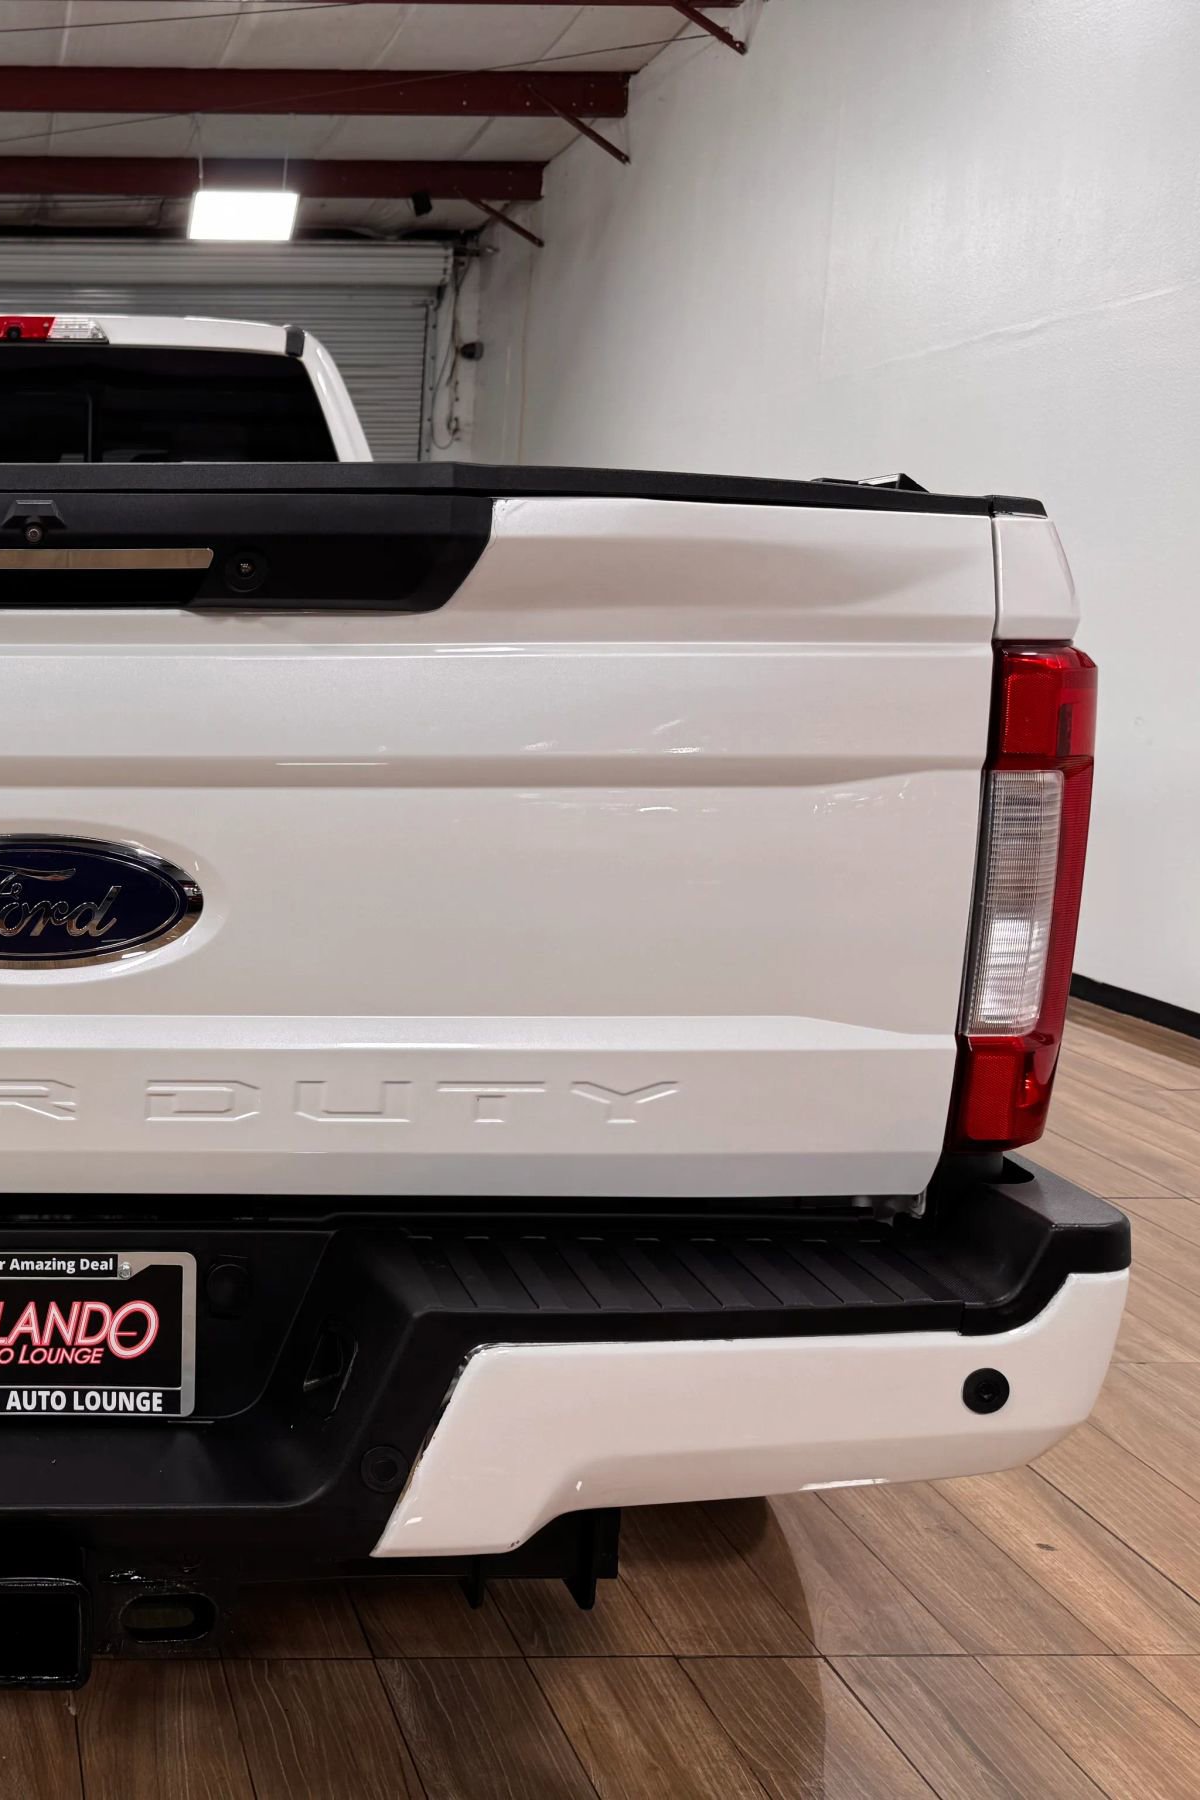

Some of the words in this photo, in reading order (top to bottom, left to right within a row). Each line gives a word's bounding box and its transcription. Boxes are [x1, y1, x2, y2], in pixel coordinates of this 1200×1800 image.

[145, 1079, 680, 1123] DUTY
[9, 1257, 76, 1274] Amazing
[79, 1257, 113, 1271] Deal
[18, 1345, 104, 1365] LOUNGE
[6, 1390, 68, 1411] AUTO
[73, 1390, 163, 1413] LOUNGE
